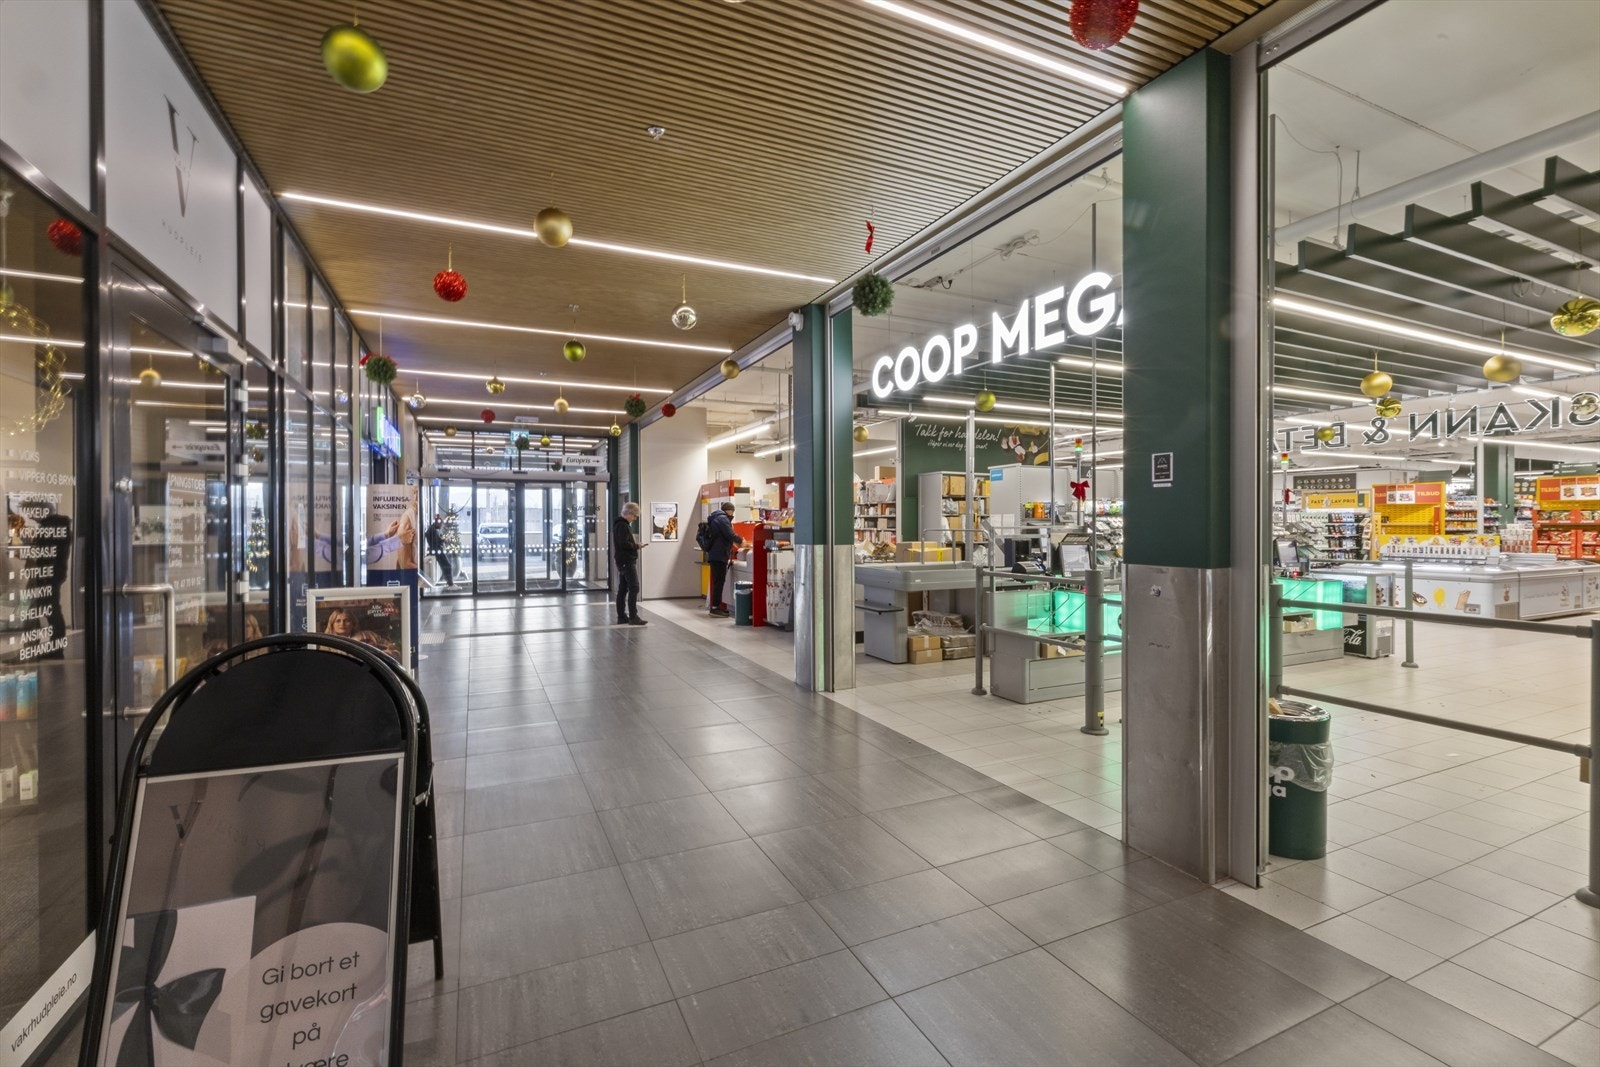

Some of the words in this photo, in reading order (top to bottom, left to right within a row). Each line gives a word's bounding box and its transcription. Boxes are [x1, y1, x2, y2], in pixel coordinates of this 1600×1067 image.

[872, 323, 978, 399] COOP
[992, 271, 1123, 364] MEG
[915, 424, 937, 437] Takk
[938, 427, 954, 441] for
[955, 426, 1001, 442] hadelen!
[21, 471, 46, 483] VIPPER
[47, 473, 58, 485] OG
[169, 473, 206, 490] PNINGSTIDER
[20, 506, 50, 519] MAKEUP
[20, 527, 67, 539] KROPPSPLEIE
[20, 546, 57, 559] MASSASJE
[20, 566, 54, 580] FOTPLEIE
[20, 586, 53, 600] MANIKYR
[20, 605, 53, 621] SHELLAC
[20, 626, 54, 643] ANSIKTS
[20, 637, 68, 660] BEHANDLING
[262, 965, 285, 986] Gi
[290, 956, 335, 981] bort
[339, 951, 361, 970] et
[260, 983, 358, 1024] gavekort
[292, 1022, 321, 1051] på
